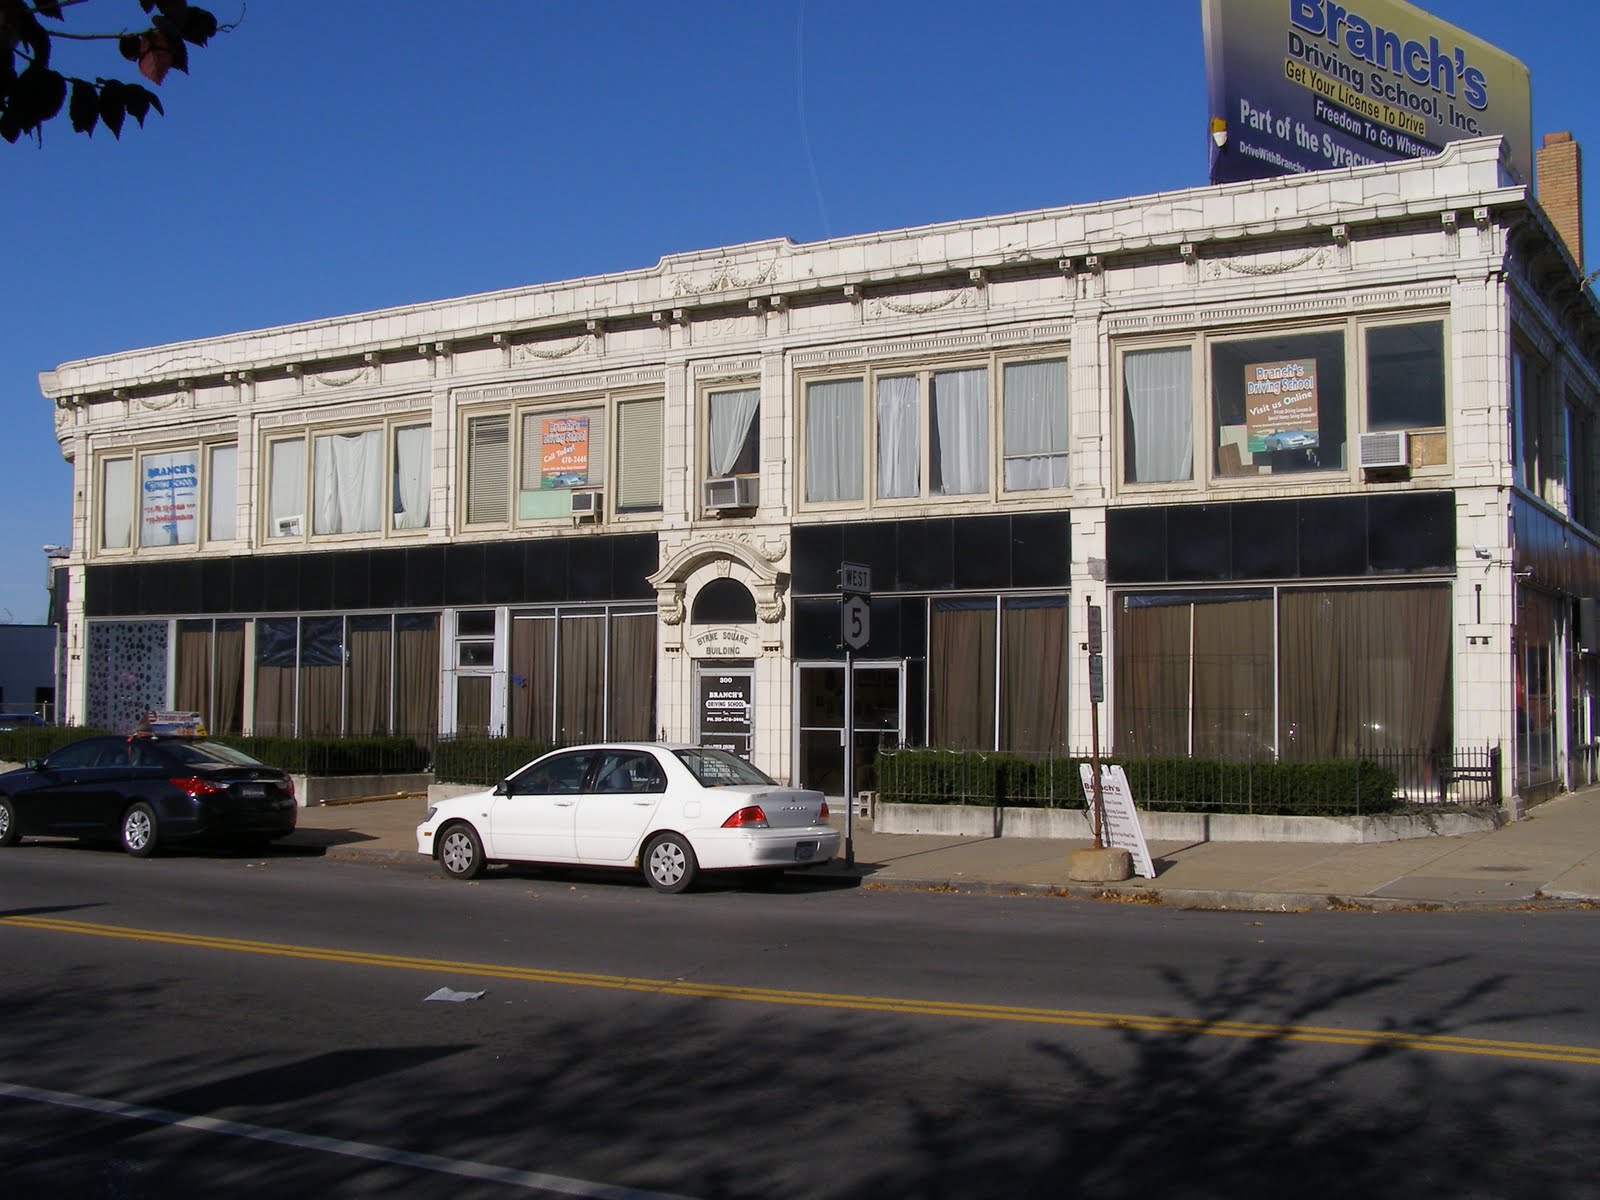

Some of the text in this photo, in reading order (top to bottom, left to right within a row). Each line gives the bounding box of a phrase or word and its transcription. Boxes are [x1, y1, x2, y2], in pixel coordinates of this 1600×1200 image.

[1289, 0, 1488, 110] Branch's
[1288, 30, 1483, 137] Driving School, Inc.
[1286, 60, 1425, 135] Get Your License To Drive
[1240, 98, 1272, 134] Part
[1276, 116, 1291, 140] of
[1295, 121, 1319, 153] the
[1316, 100, 1361, 135] Freedom
[1364, 122, 1377, 142] To
[1380, 129, 1394, 148] Go
[1256, 363, 1304, 381] Branch's
[1247, 376, 1314, 395] Driving School
[1249, 391, 1313, 416] Visit us Online
[543, 452, 556, 463] Call
[846, 569, 868, 587] WEST
[851, 607, 862, 638] 5
[697, 632, 749, 646] BYRNE SQUARE
[706, 647, 740, 655] BUILDING
[709, 691, 743, 699] BRANCH'S
